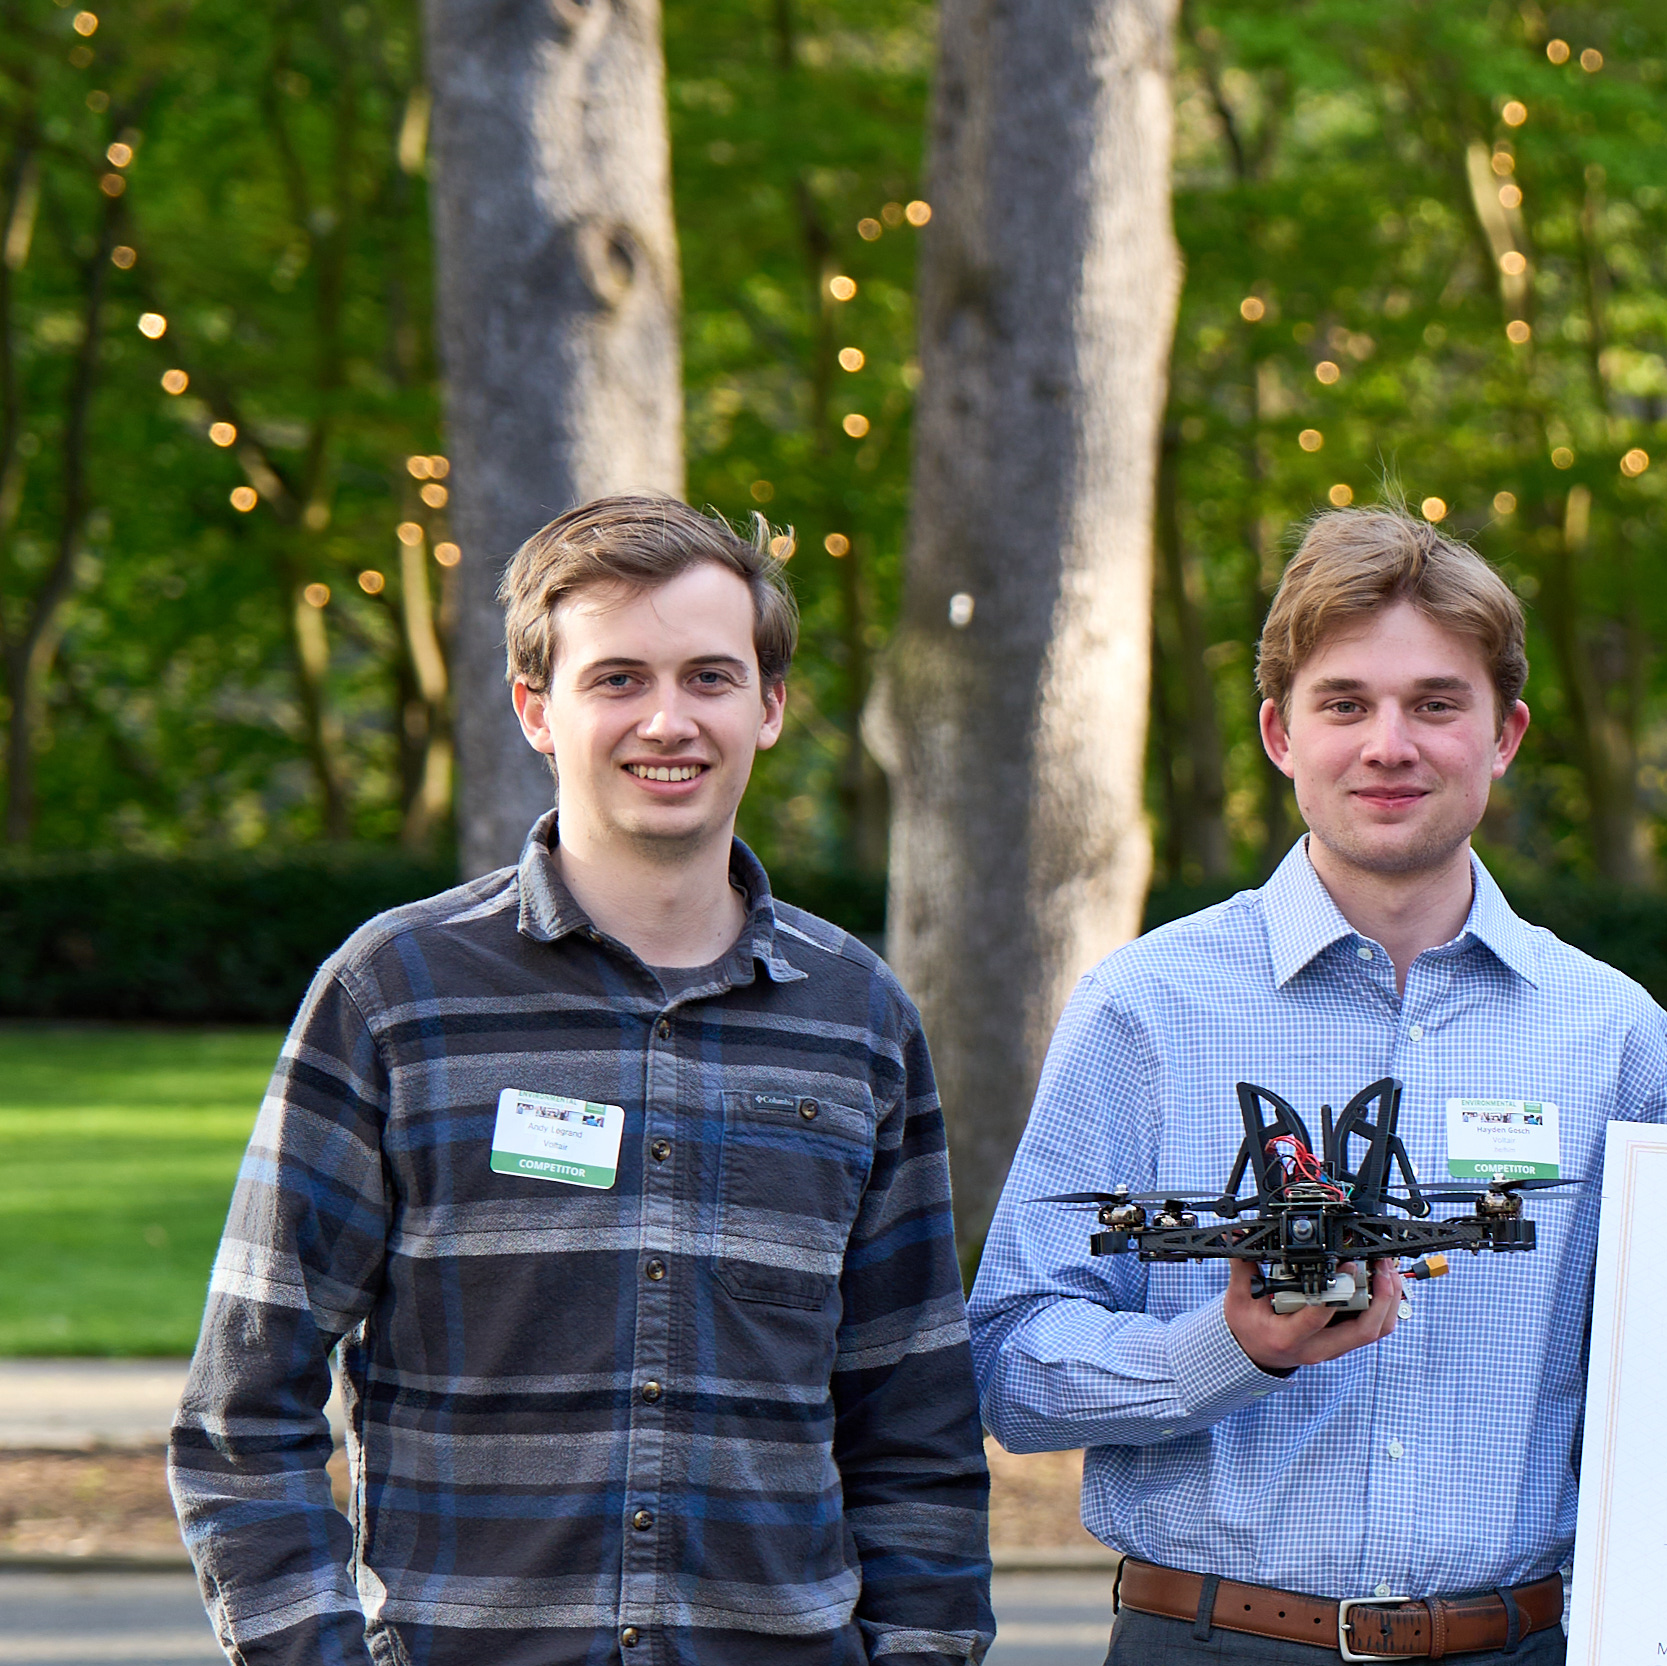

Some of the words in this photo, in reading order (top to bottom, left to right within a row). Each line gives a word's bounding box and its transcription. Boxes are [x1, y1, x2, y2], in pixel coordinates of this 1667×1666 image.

[1477, 1126, 1506, 1134] Hayden
[519, 1159, 586, 1177] COMPETITOR
[1474, 1164, 1536, 1174] COMPETITOR
